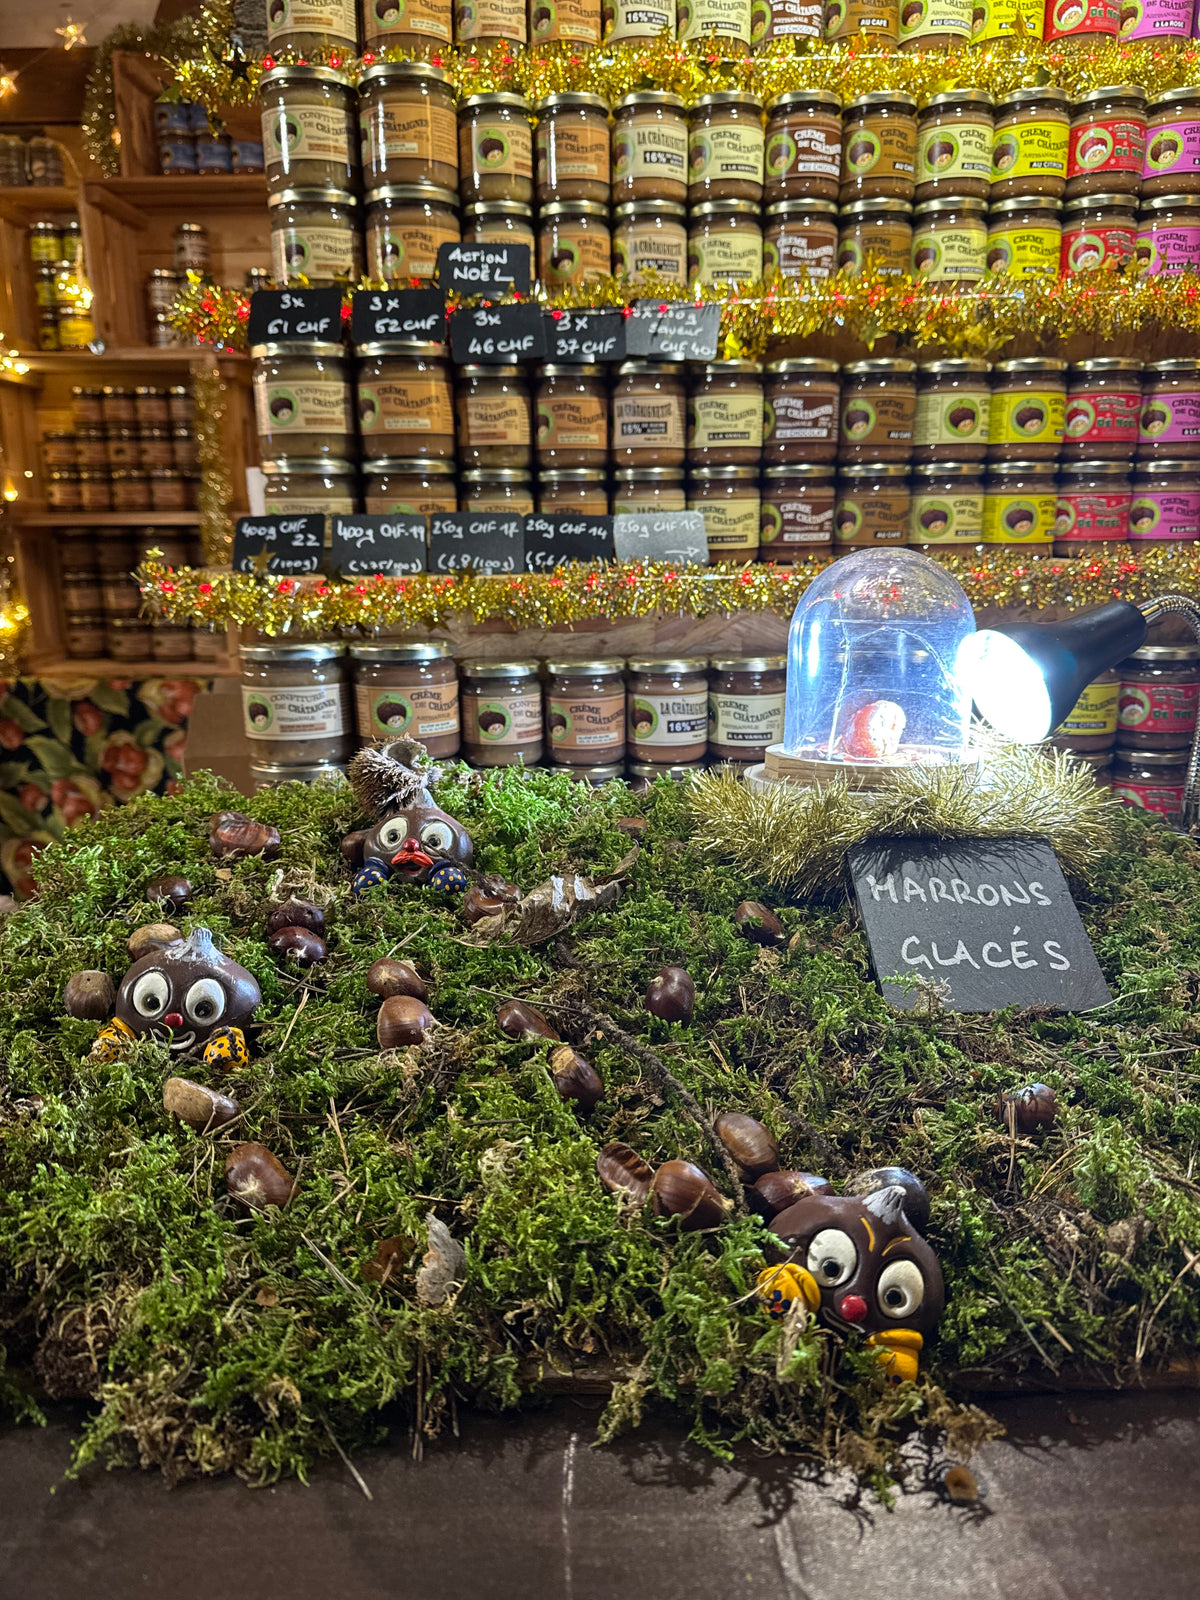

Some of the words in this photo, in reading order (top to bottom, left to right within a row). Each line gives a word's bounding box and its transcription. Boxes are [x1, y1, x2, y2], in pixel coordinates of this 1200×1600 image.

[296, 317, 331, 334] CHF
[402, 314, 440, 332] CHF
[468, 337, 495, 355] 46
[496, 335, 535, 352] CHF
[556, 337, 579, 356] 37
[582, 337, 617, 354] CHF
[659, 340, 689, 352] CHF
[432, 521, 464, 539] 250g
[469, 521, 496, 534] CHF
[526, 519, 554, 538] 250g
[559, 522, 586, 535] CHF
[588, 527, 608, 542] 14
[653, 521, 677, 532] CHF
[291, 533, 320, 547] 22
[669, 722, 691, 732] 16%
[866, 872, 1052, 906] MARRONS
[901, 925, 1071, 970] GLACÉS
